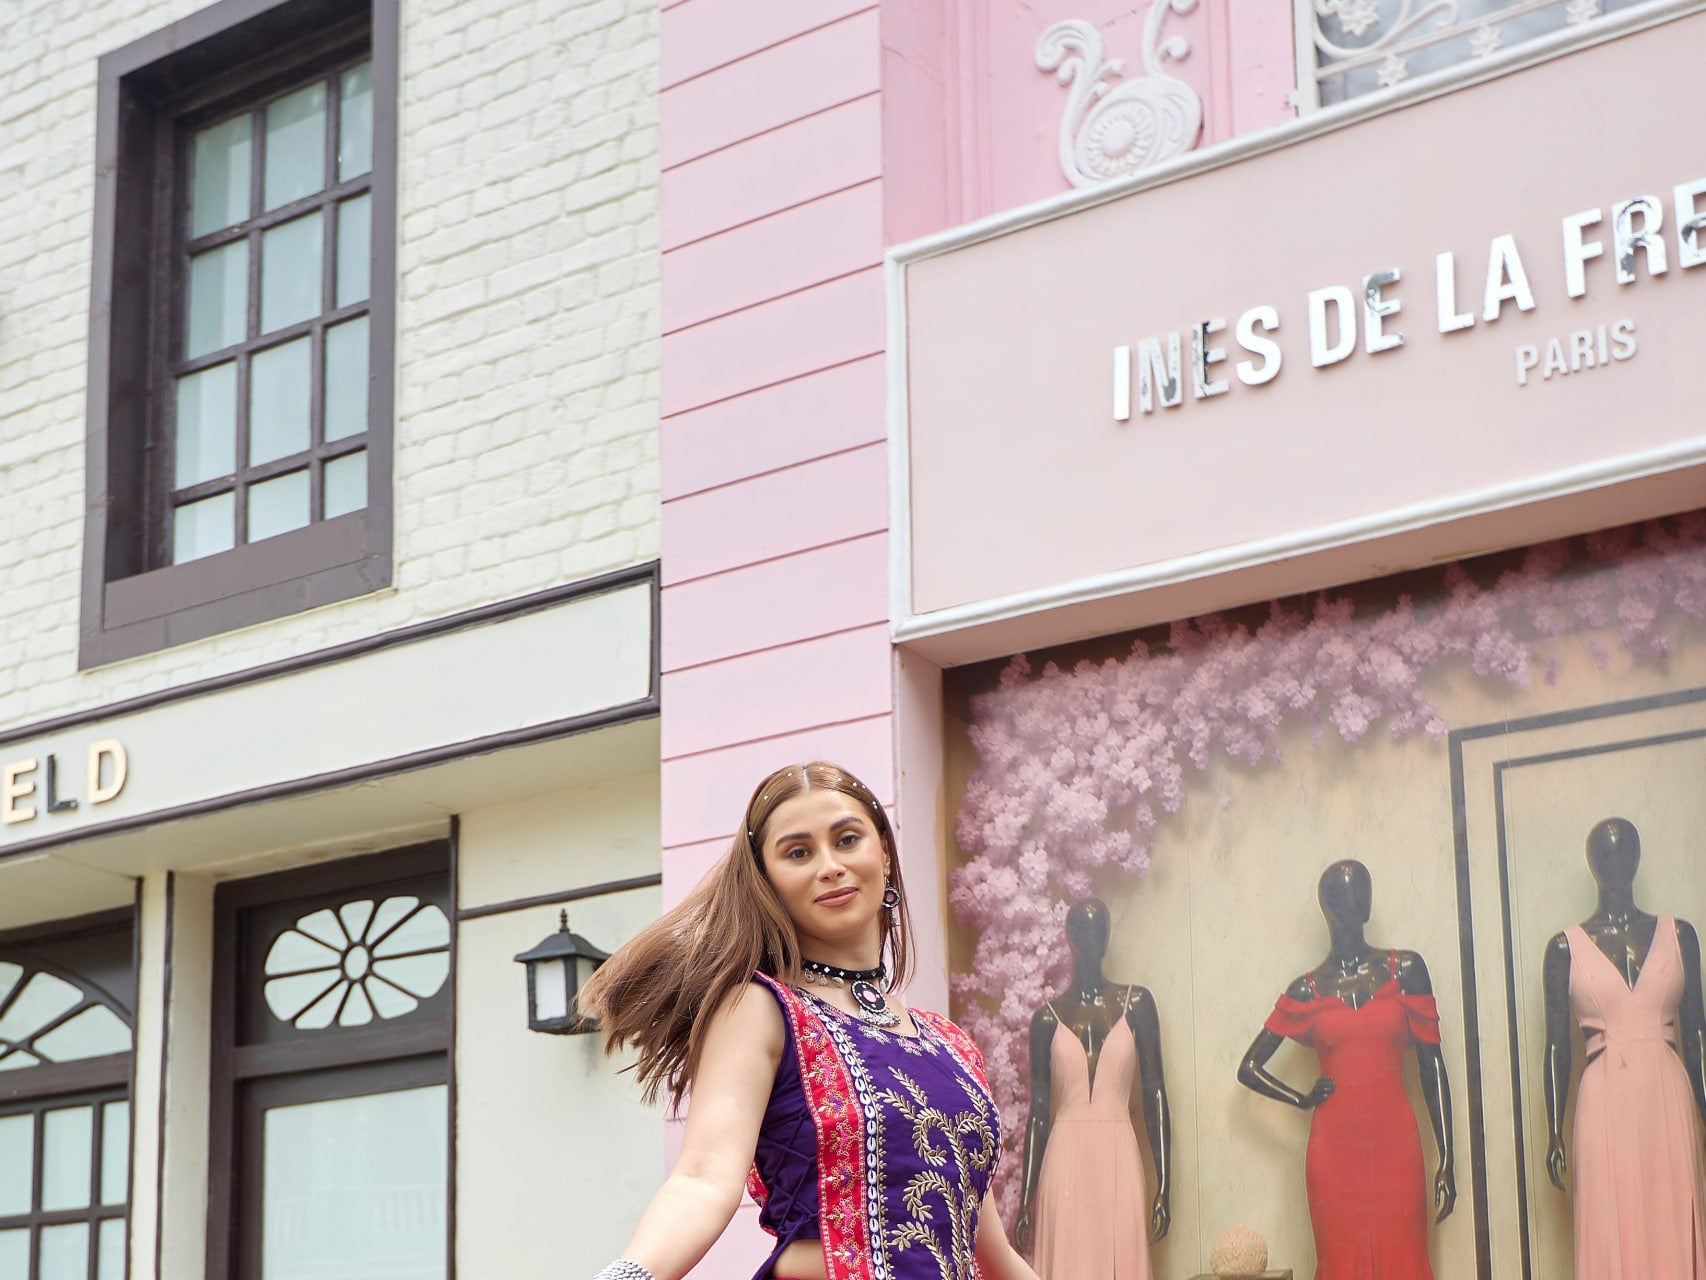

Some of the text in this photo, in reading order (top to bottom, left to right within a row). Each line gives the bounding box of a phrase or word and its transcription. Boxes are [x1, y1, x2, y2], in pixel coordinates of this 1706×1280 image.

[1113, 305, 1282, 420] INES
[1308, 267, 1405, 368] DE
[1436, 233, 1536, 334] LA
[1515, 318, 1638, 386] PARIS
